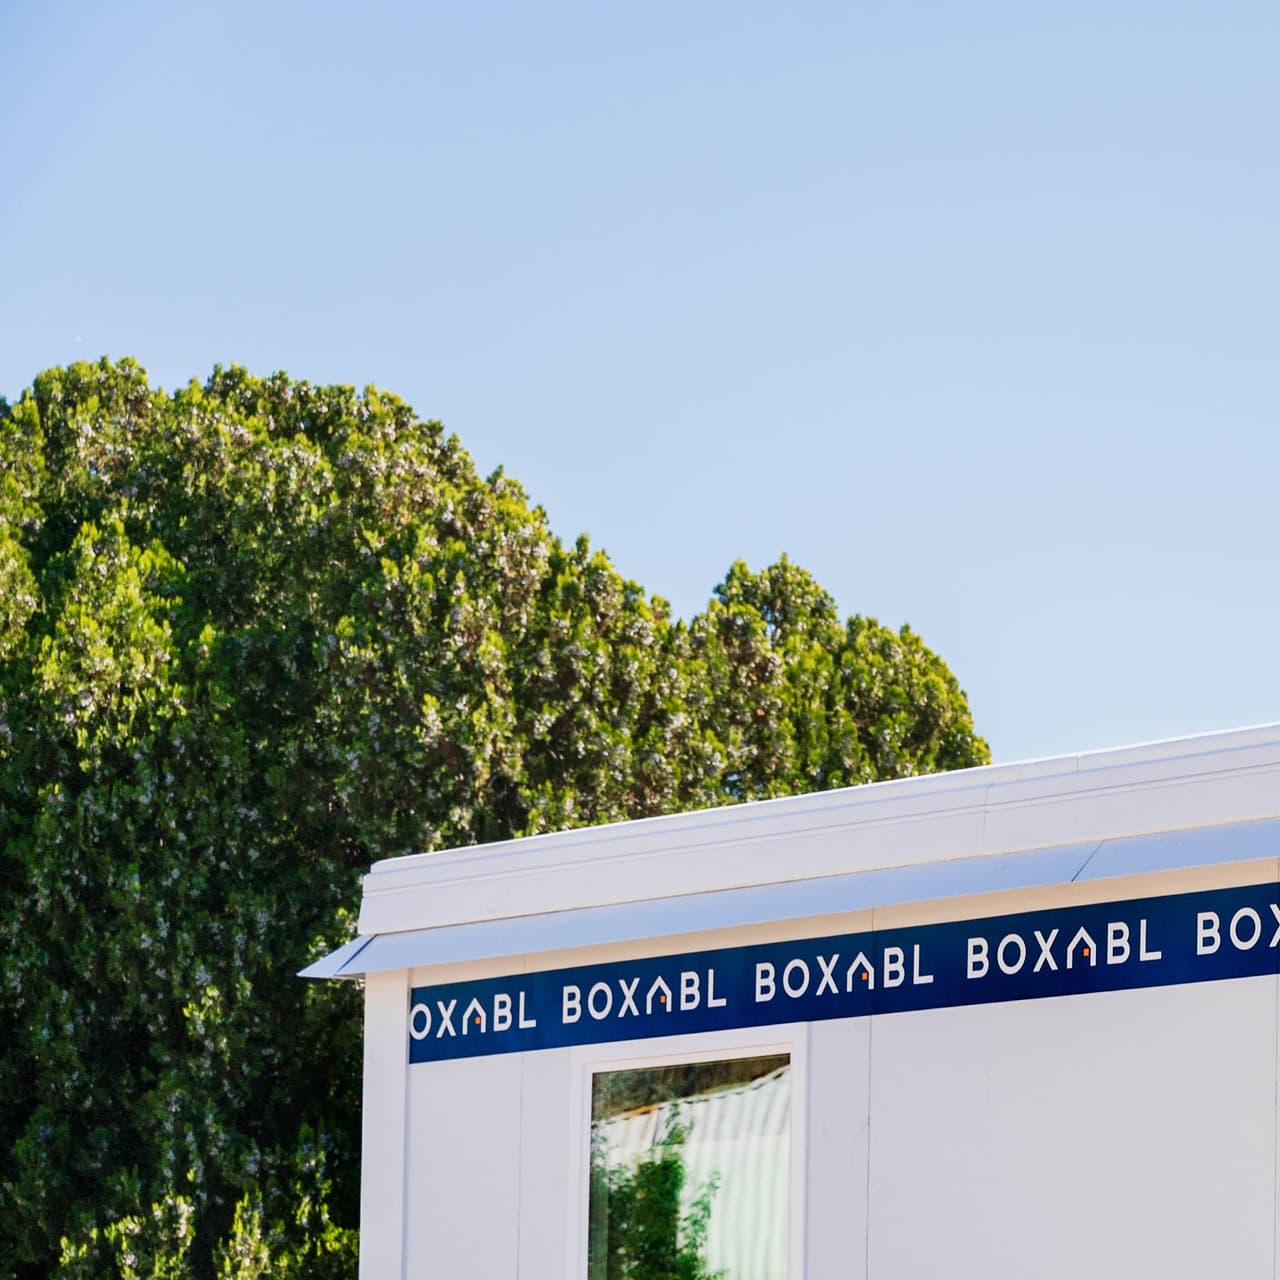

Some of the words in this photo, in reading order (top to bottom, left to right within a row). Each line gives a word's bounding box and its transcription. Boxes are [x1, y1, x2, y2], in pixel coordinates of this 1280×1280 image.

[563, 969, 726, 1024] BOXABL
[756, 945, 934, 1003] BOXABL
[967, 920, 1162, 979] BOXABL
